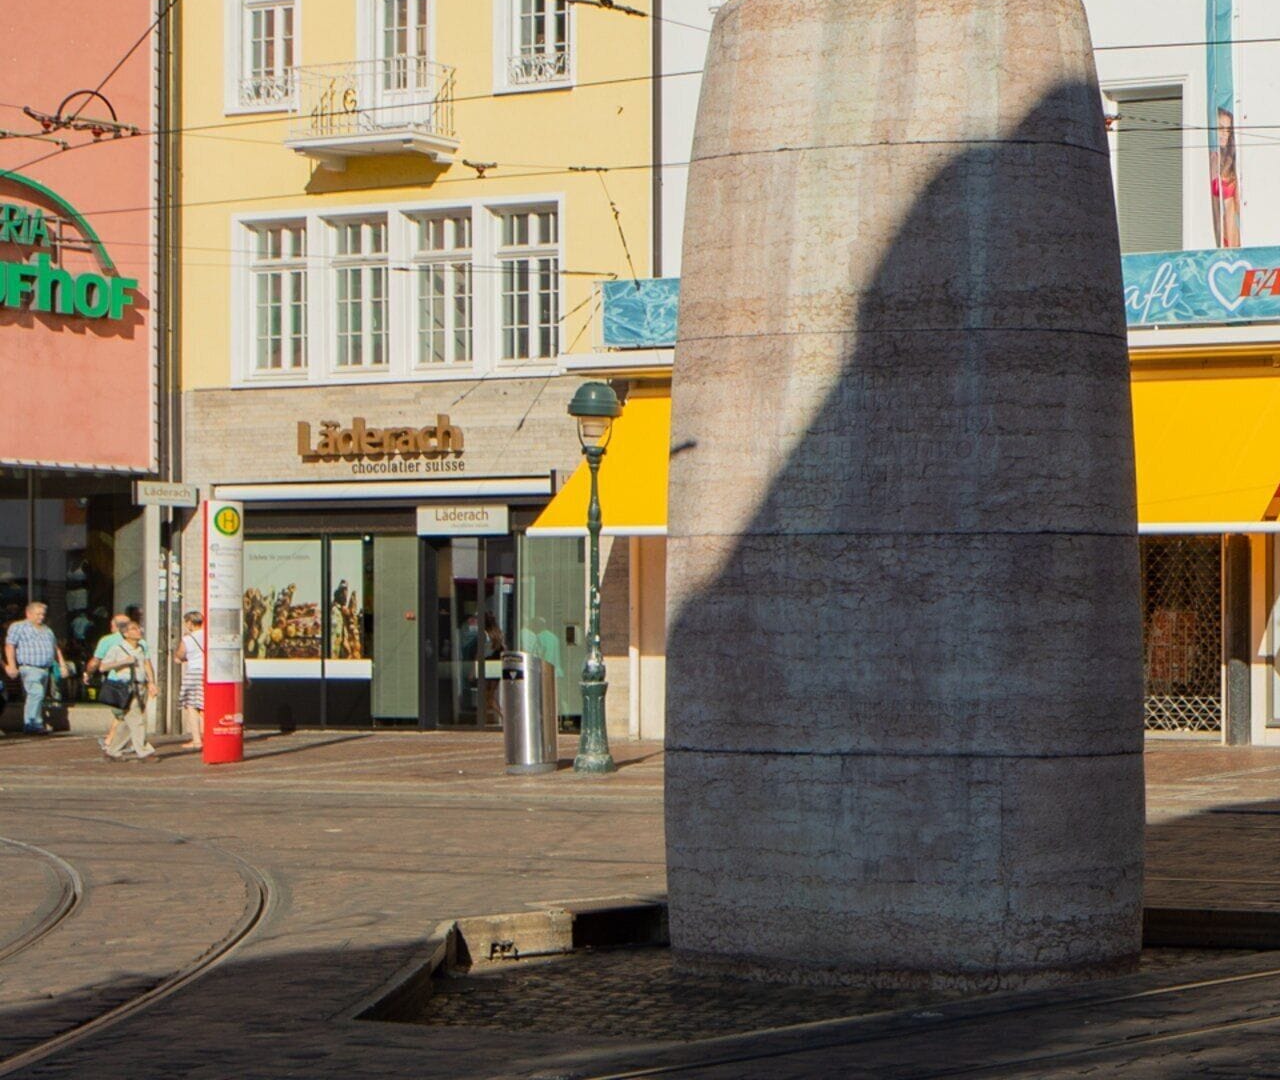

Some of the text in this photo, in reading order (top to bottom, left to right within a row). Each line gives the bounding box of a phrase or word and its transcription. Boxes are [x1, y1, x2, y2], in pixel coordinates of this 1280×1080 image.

[0, 203, 51, 247] RIA
[297, 413, 464, 456] Läderach
[351, 459, 465, 474] chocolatier suisse
